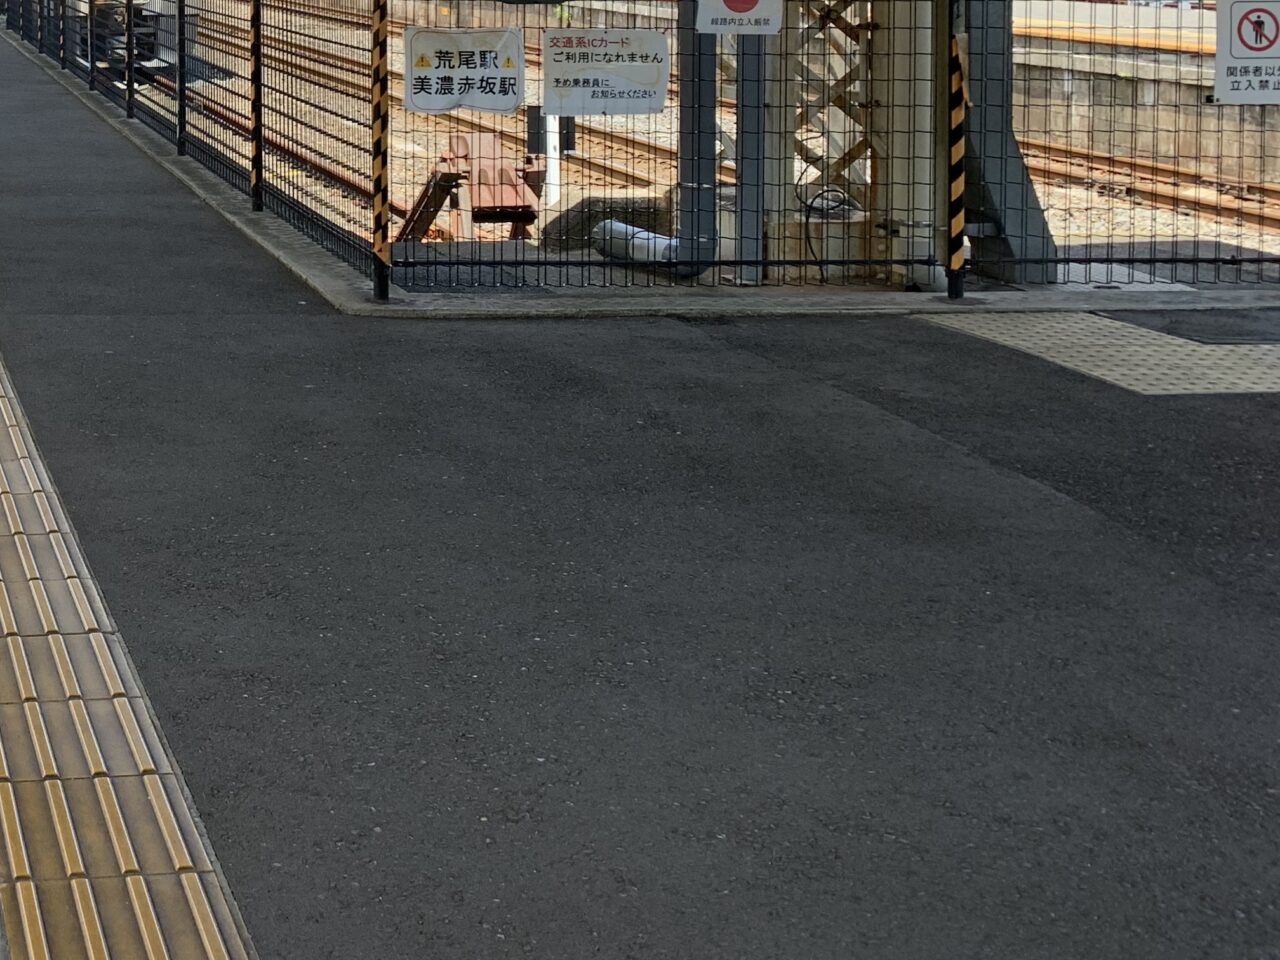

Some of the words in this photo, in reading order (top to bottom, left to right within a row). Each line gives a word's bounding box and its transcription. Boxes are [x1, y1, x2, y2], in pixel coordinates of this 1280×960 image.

[549, 36, 631, 49] 交通系ICカード
[434, 50, 499, 70] 荒尾駅
[553, 51, 664, 64] ご利用になれません
[412, 75, 517, 96] 美濃赤坂駅
[553, 78, 610, 88] 予め乗務員に
[591, 89, 657, 99] お知らせください
